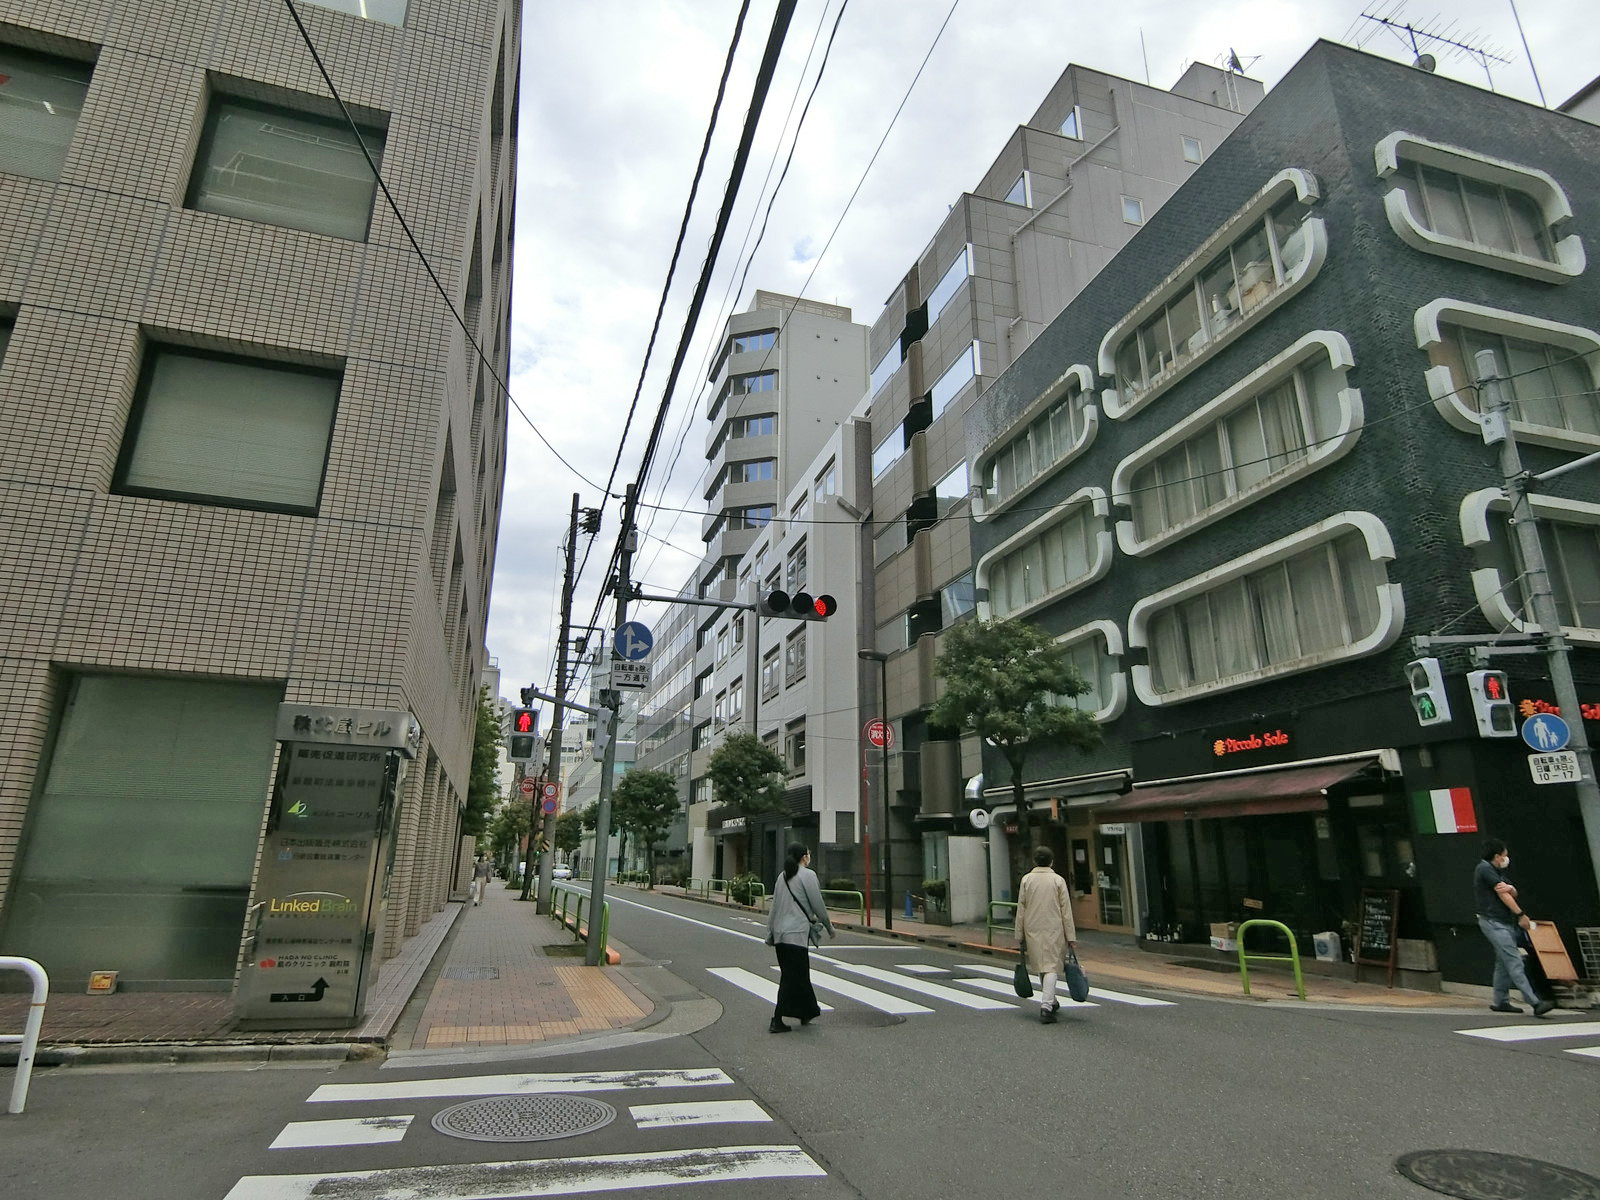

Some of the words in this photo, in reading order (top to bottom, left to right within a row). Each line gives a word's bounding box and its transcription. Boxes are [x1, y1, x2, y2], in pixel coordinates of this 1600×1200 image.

[614, 663, 650, 673] 自転車を除く
[614, 673, 649, 683] 一方通行
[1225, 733, 1263, 753] Piccolo
[1263, 729, 1289, 747] Sole
[1533, 755, 1573, 765] 自転車を除く
[546, 786, 555, 794] 30
